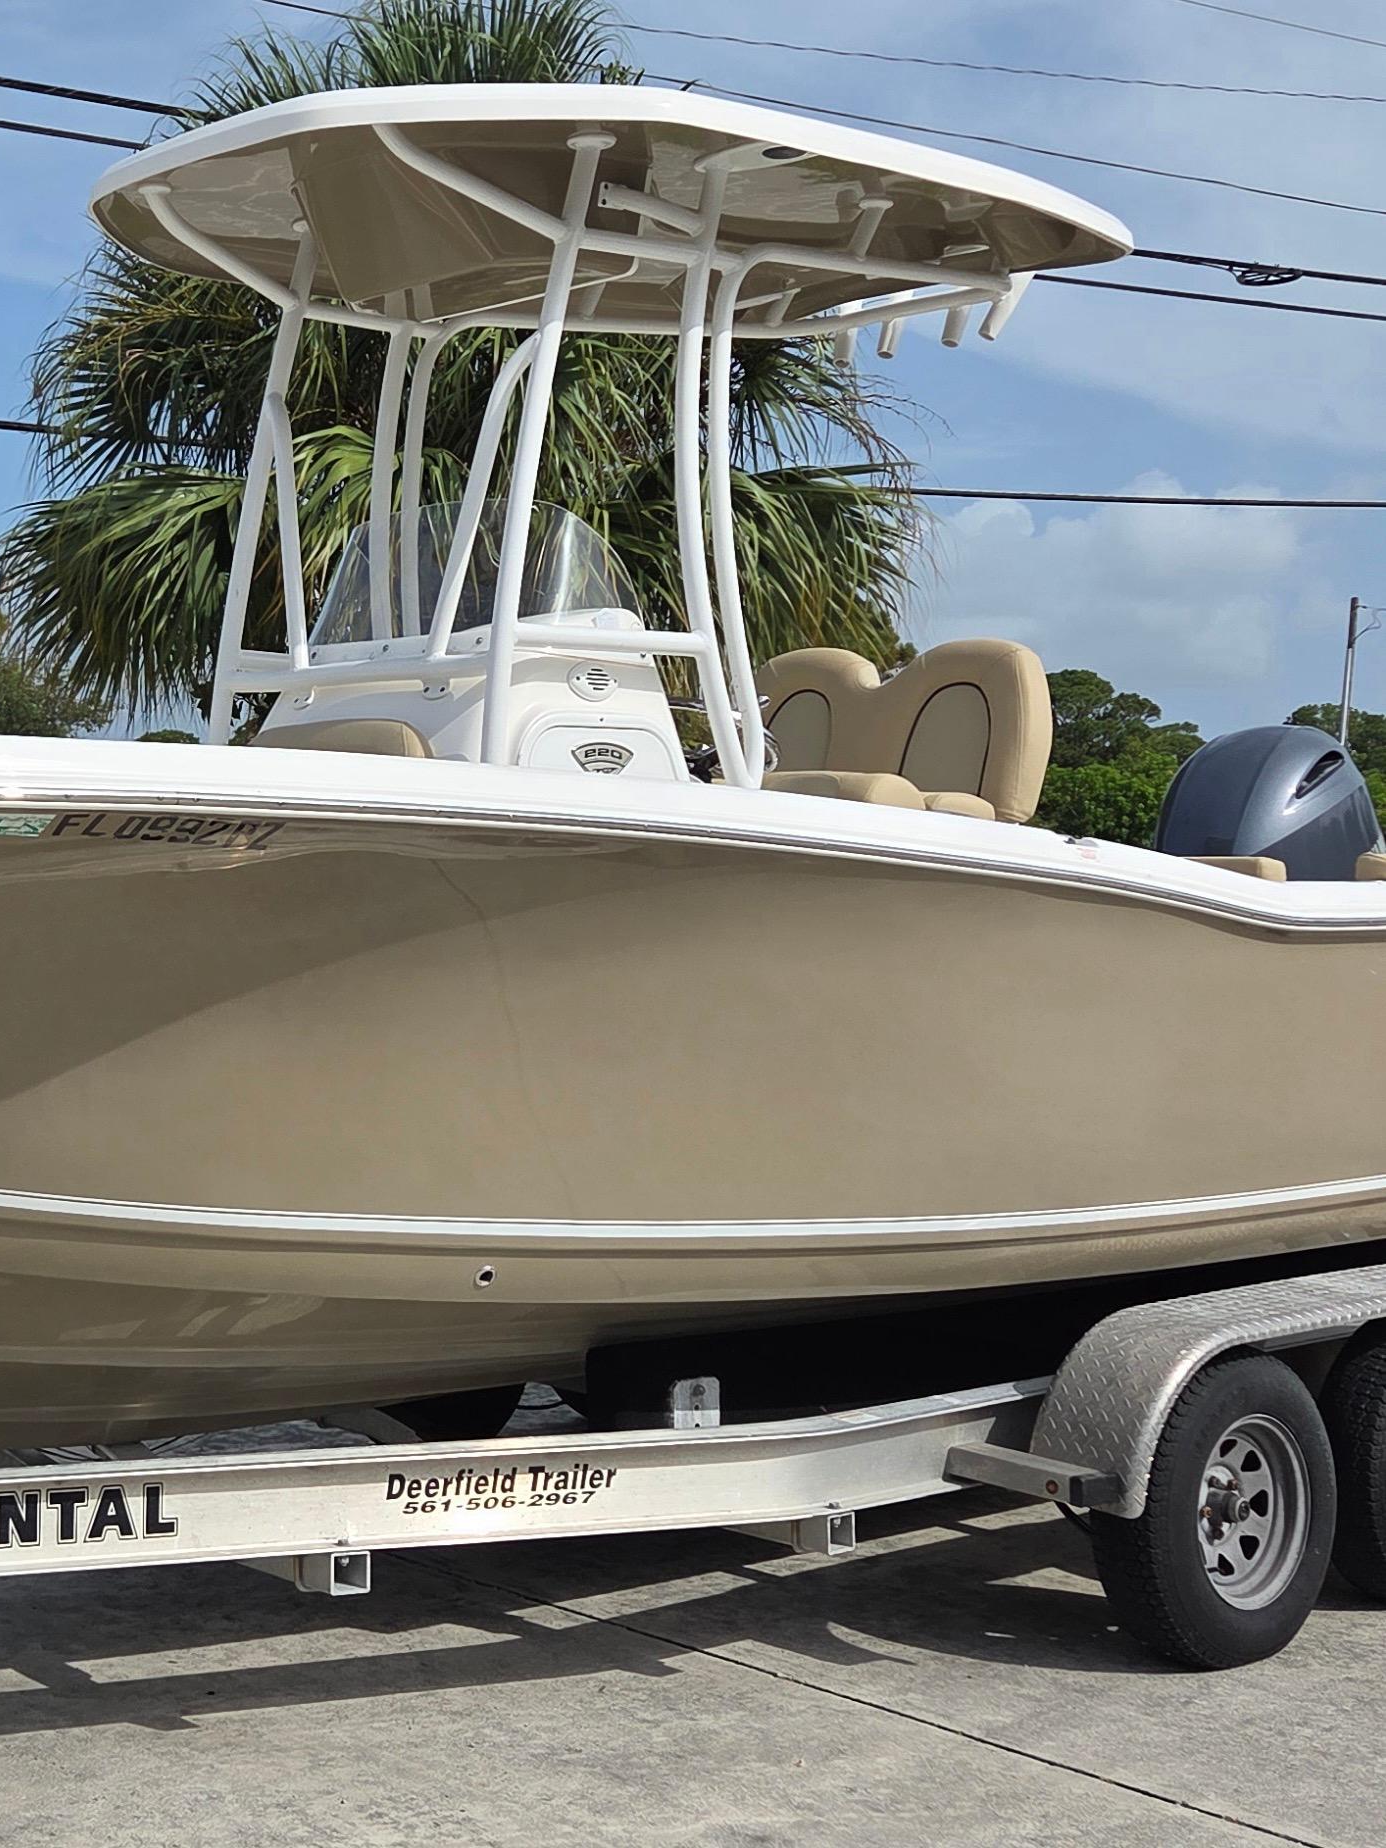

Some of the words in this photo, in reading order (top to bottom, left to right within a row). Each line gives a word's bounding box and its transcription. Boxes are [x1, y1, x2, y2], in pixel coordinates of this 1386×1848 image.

[584, 748, 622, 760] 220
[52, 813, 106, 836] FL
[386, 1467, 517, 1500] Deerfield
[528, 1463, 617, 1493] Trailer
[402, 1490, 596, 1514] 561-506-2967
